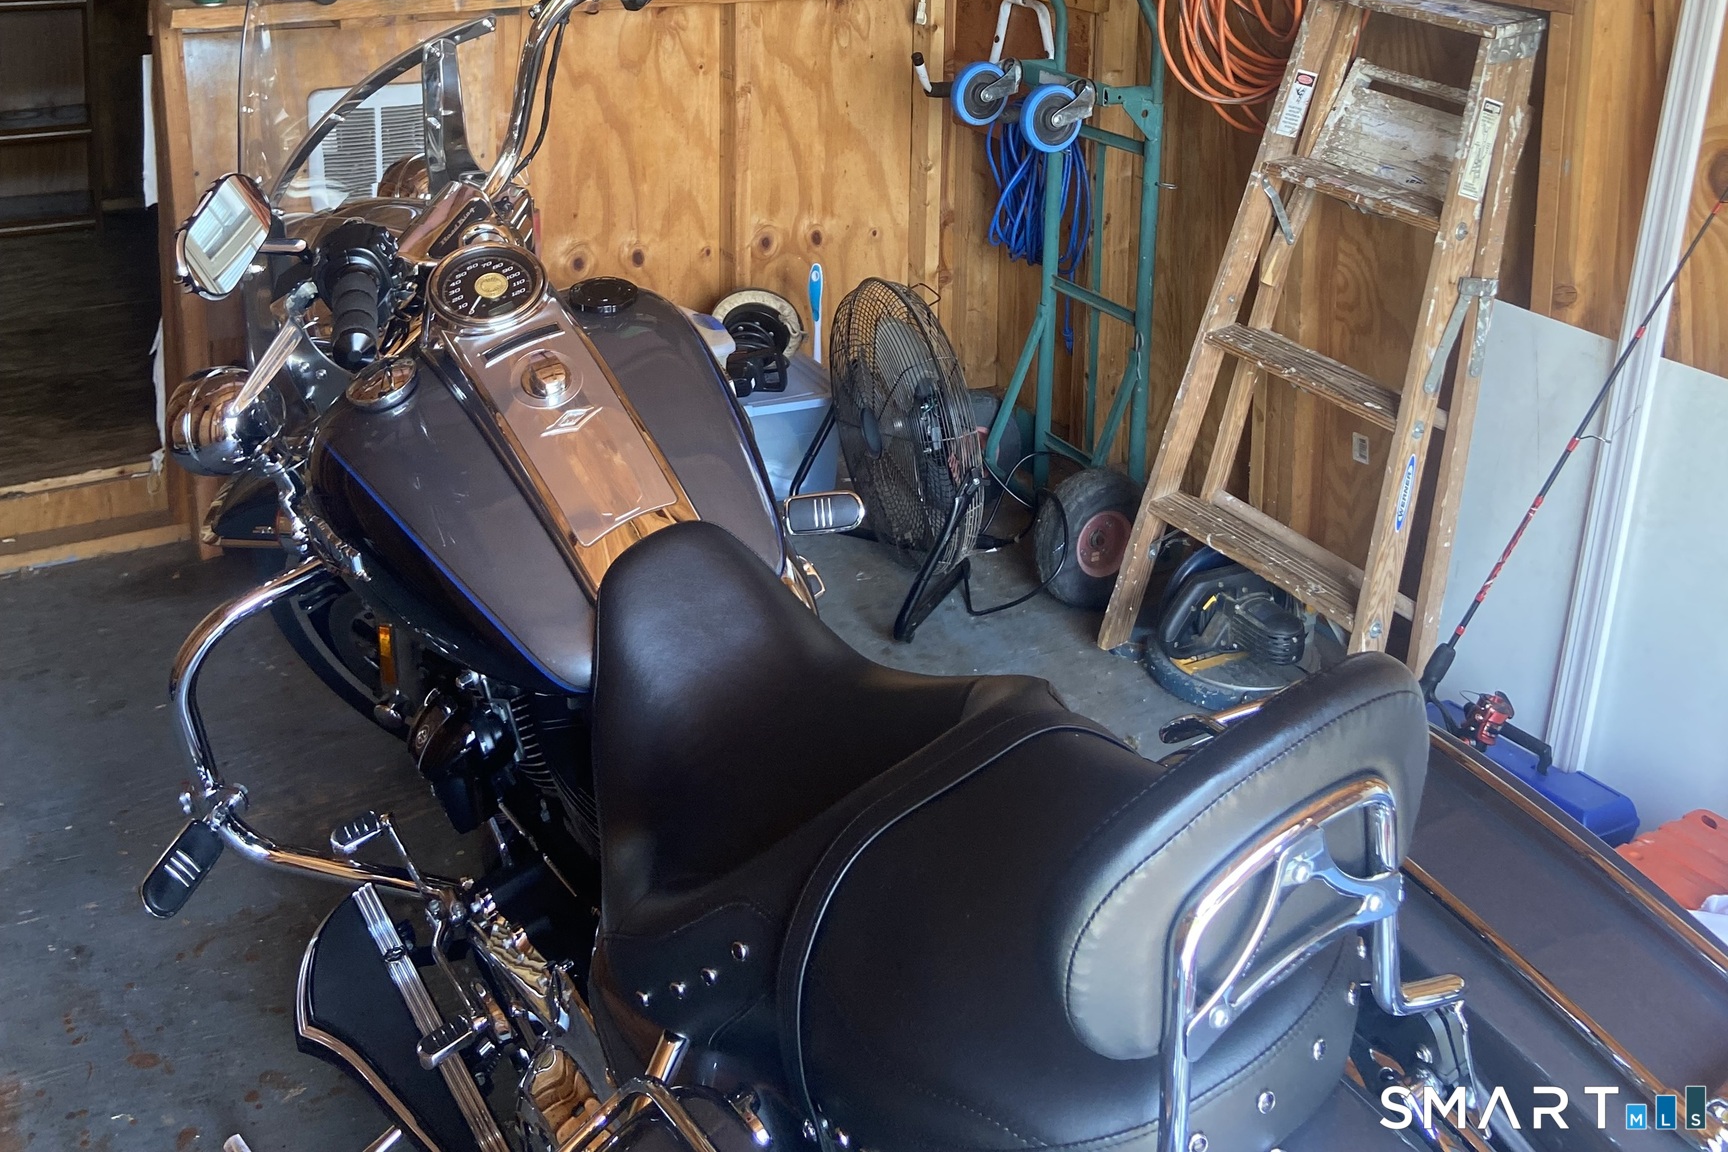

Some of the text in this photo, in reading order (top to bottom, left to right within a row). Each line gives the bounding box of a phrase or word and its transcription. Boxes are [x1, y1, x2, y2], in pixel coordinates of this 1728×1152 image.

[466, 263, 479, 271] 60
[492, 262, 504, 270] 80
[502, 266, 514, 274] 90
[455, 271, 467, 280] 50
[507, 271, 521, 280] 100
[449, 279, 462, 287] 40
[512, 278, 526, 287] 110
[448, 287, 461, 296] 30
[511, 287, 526, 297] 120
[451, 294, 464, 303] 20
[458, 302, 469, 310] 10
[1397, 471, 1412, 517] WERNER
